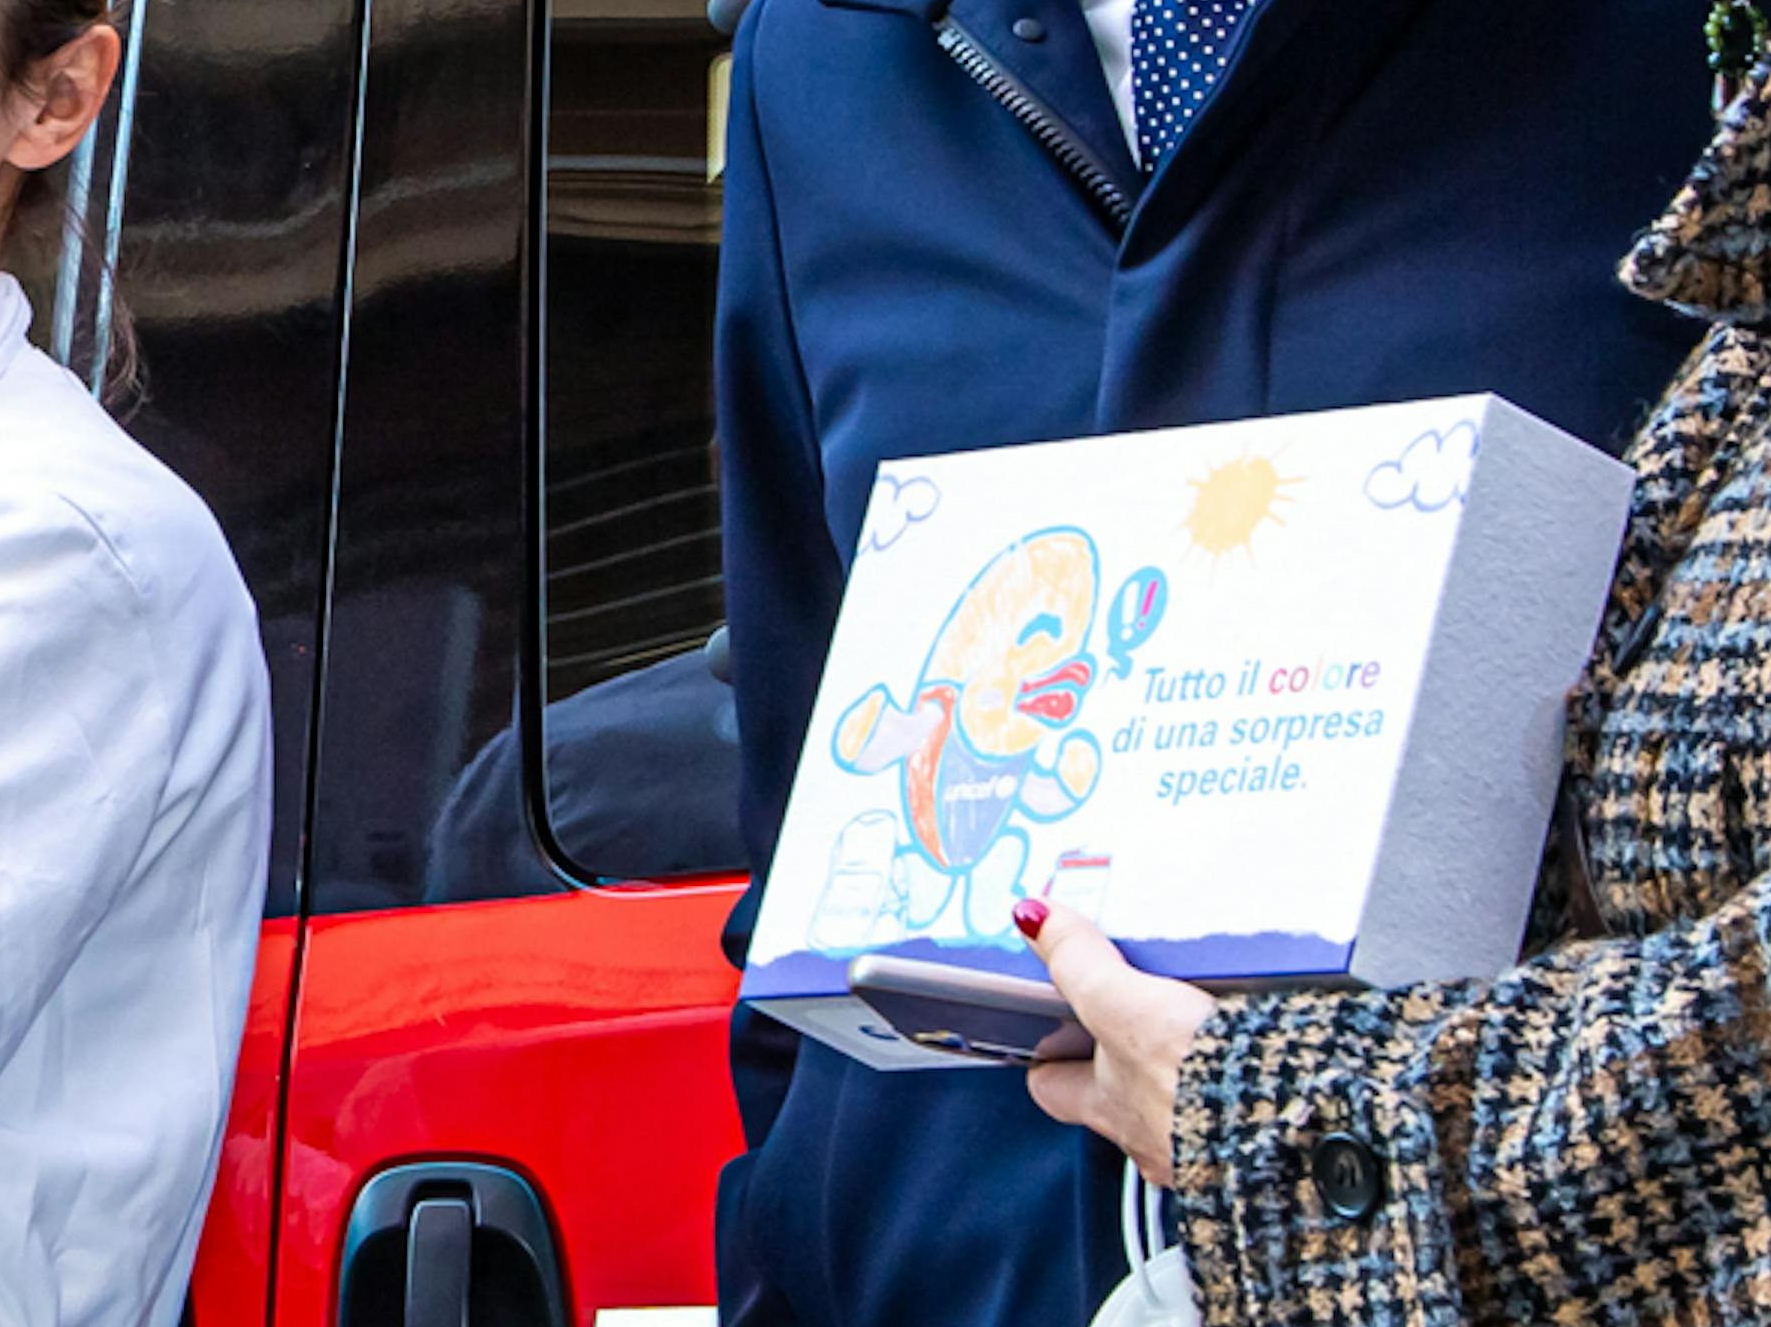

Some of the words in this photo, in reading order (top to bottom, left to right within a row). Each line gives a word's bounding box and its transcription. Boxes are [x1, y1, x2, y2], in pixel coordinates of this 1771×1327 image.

[1144, 666, 1227, 704] Tutto
[1237, 659, 1261, 696] il
[1269, 656, 1381, 694] colore
[1112, 716, 1148, 753] di
[1154, 719, 1218, 751] una
[1229, 708, 1385, 750] sorpresa
[1156, 755, 1306, 806] speciale.
